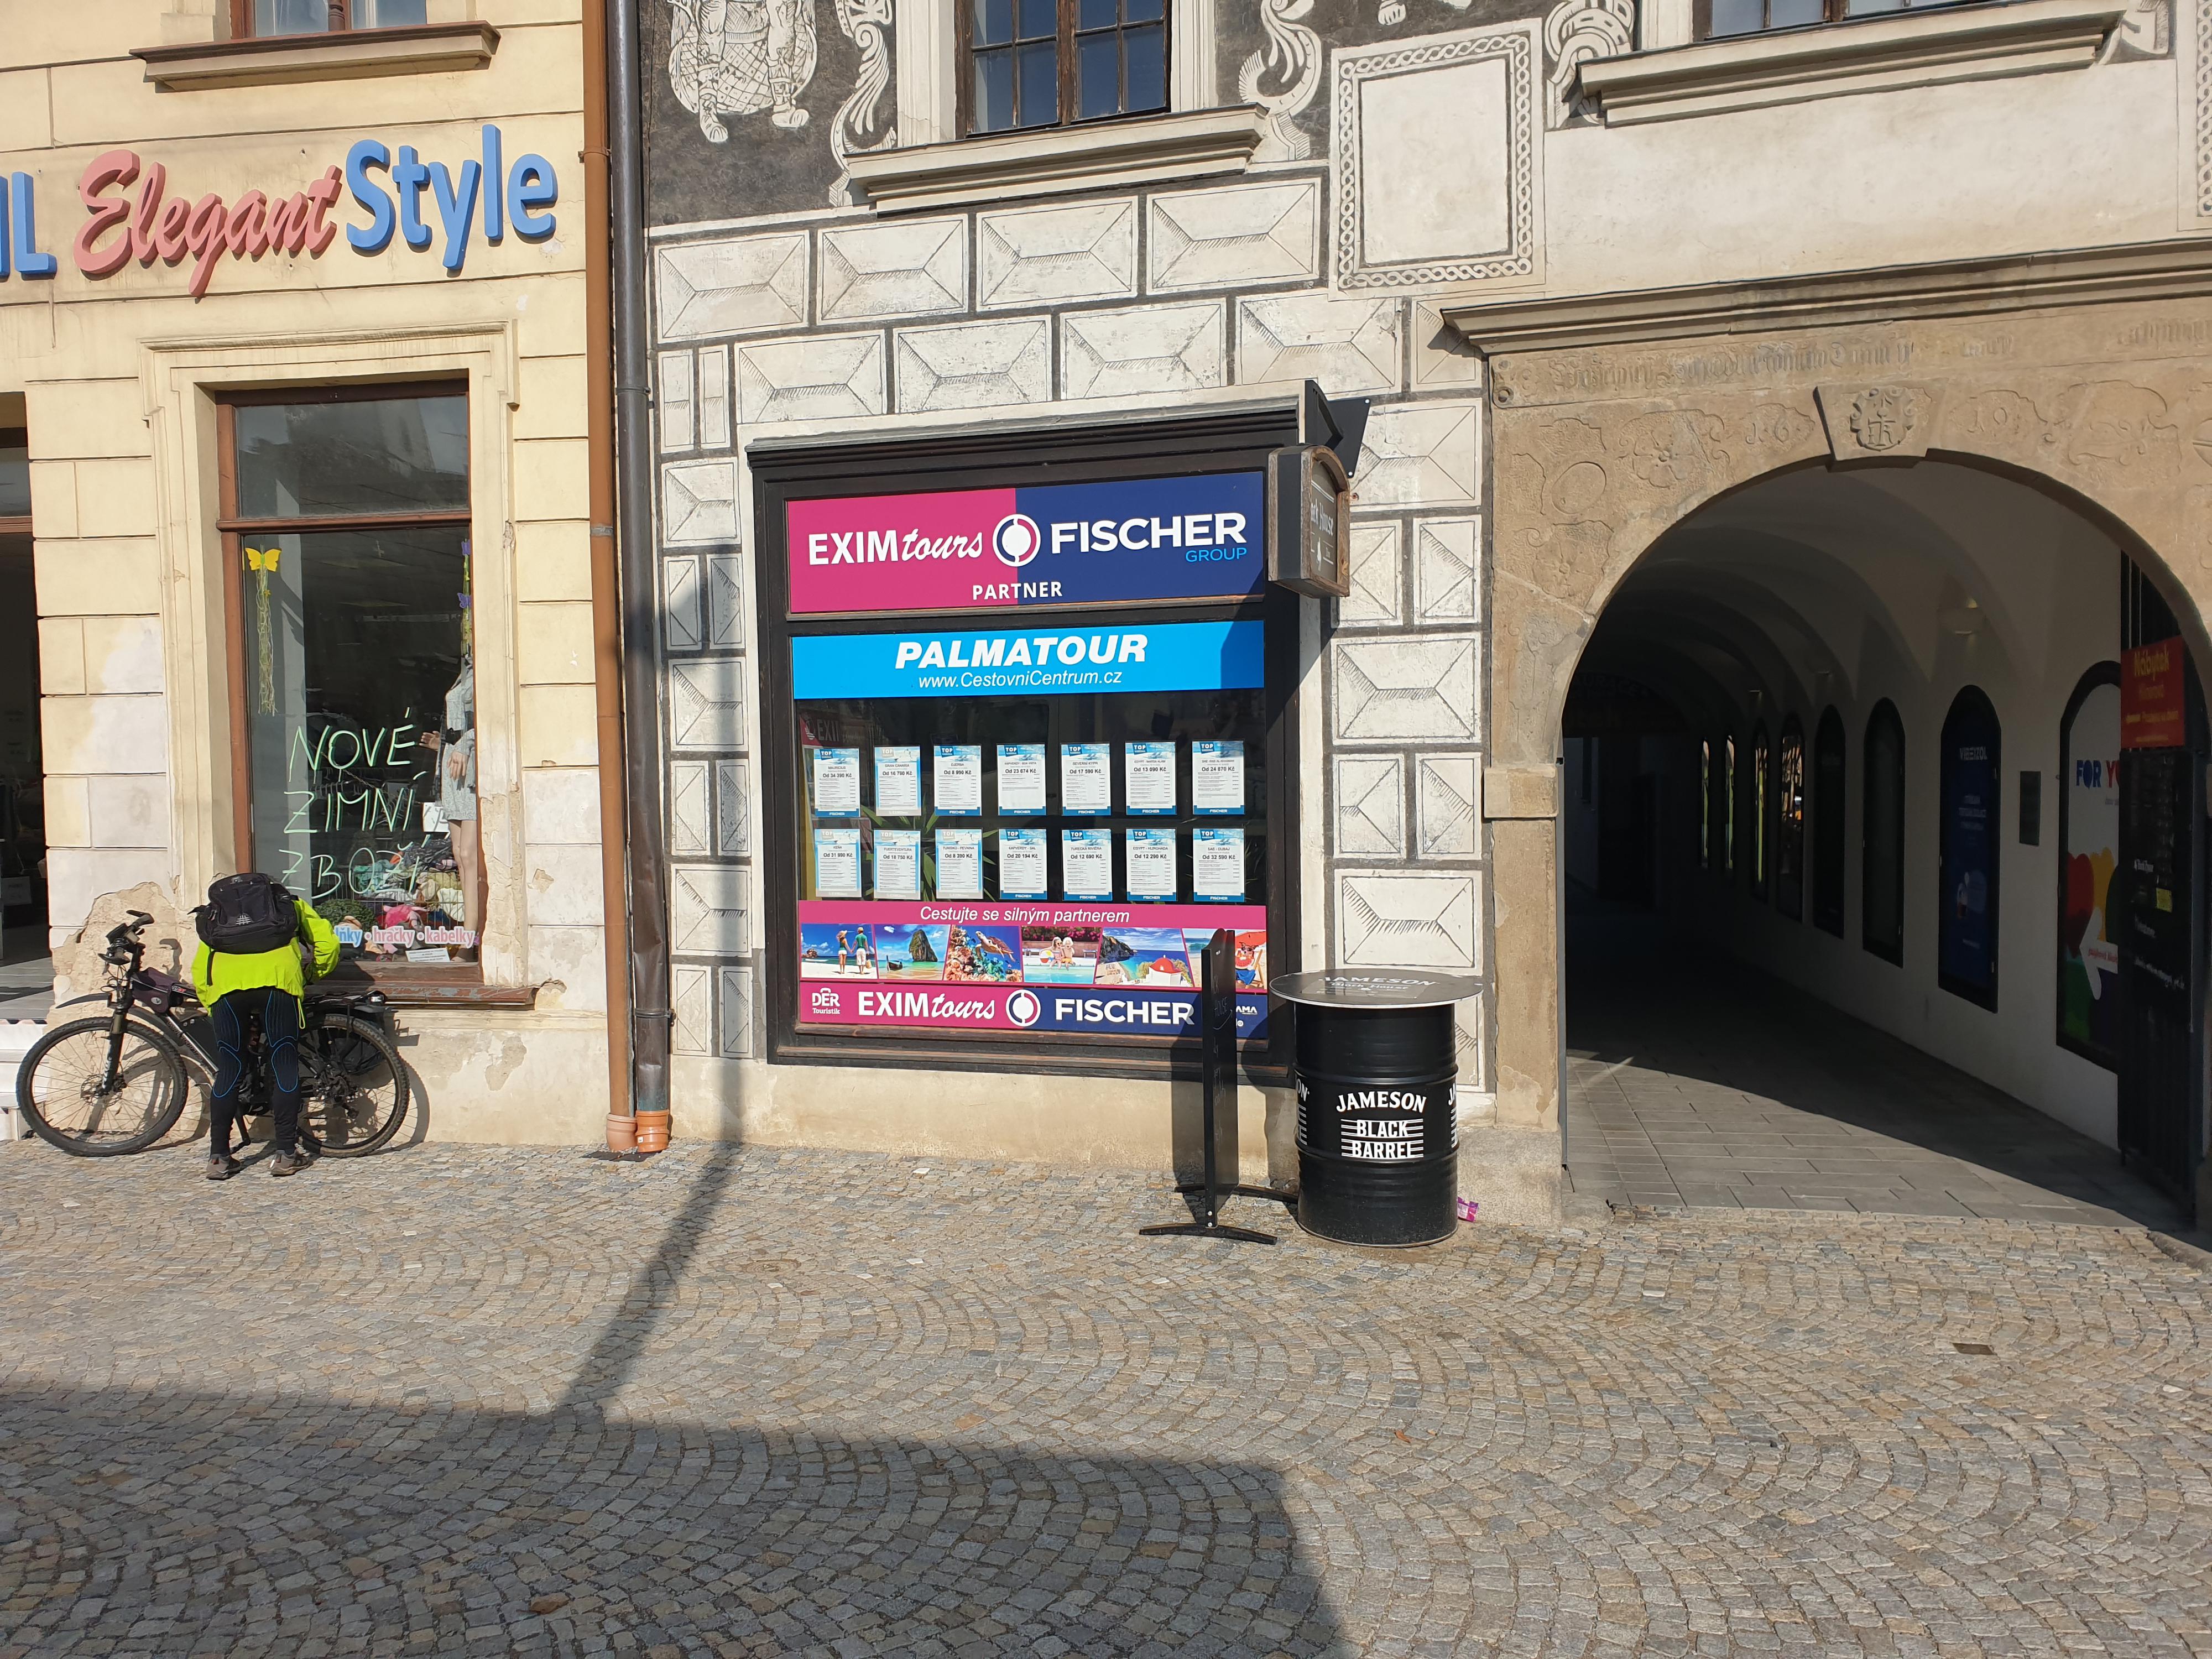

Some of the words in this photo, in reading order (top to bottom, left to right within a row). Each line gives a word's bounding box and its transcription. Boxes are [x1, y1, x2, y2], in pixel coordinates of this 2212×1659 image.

[72, 149, 341, 297] Elegant
[346, 124, 557, 271] Style
[1051, 513, 1246, 555] FISCHER
[1185, 547, 1247, 562] GROUP
[973, 581, 1062, 600] PARTNER
[896, 634, 1147, 669] PALMATOUR
[919, 670, 1122, 688] www.CestovniCentrum.cz
[289, 707, 416, 781] NOVÉ
[2076, 760, 2101, 788] FOR
[284, 771, 426, 834] ZIMNÍ
[279, 834, 431, 899] ZBOŽÍ
[921, 906, 978, 924] Cestujte
[983, 910, 999, 920] se
[1004, 907, 1049, 924] silným
[1054, 909, 1130, 924] partnerem
[374, 927, 414, 947] hračky
[426, 928, 473, 947] kabelky
[1318, 977, 1436, 986] JAMESON
[812, 992, 839, 1007] DER
[1055, 999, 1194, 1025] FISCHER
[1336, 1091, 1427, 1113] JAMESON
[1357, 1119, 1408, 1137] BLACK
[1353, 1141, 1413, 1159] BARREL
